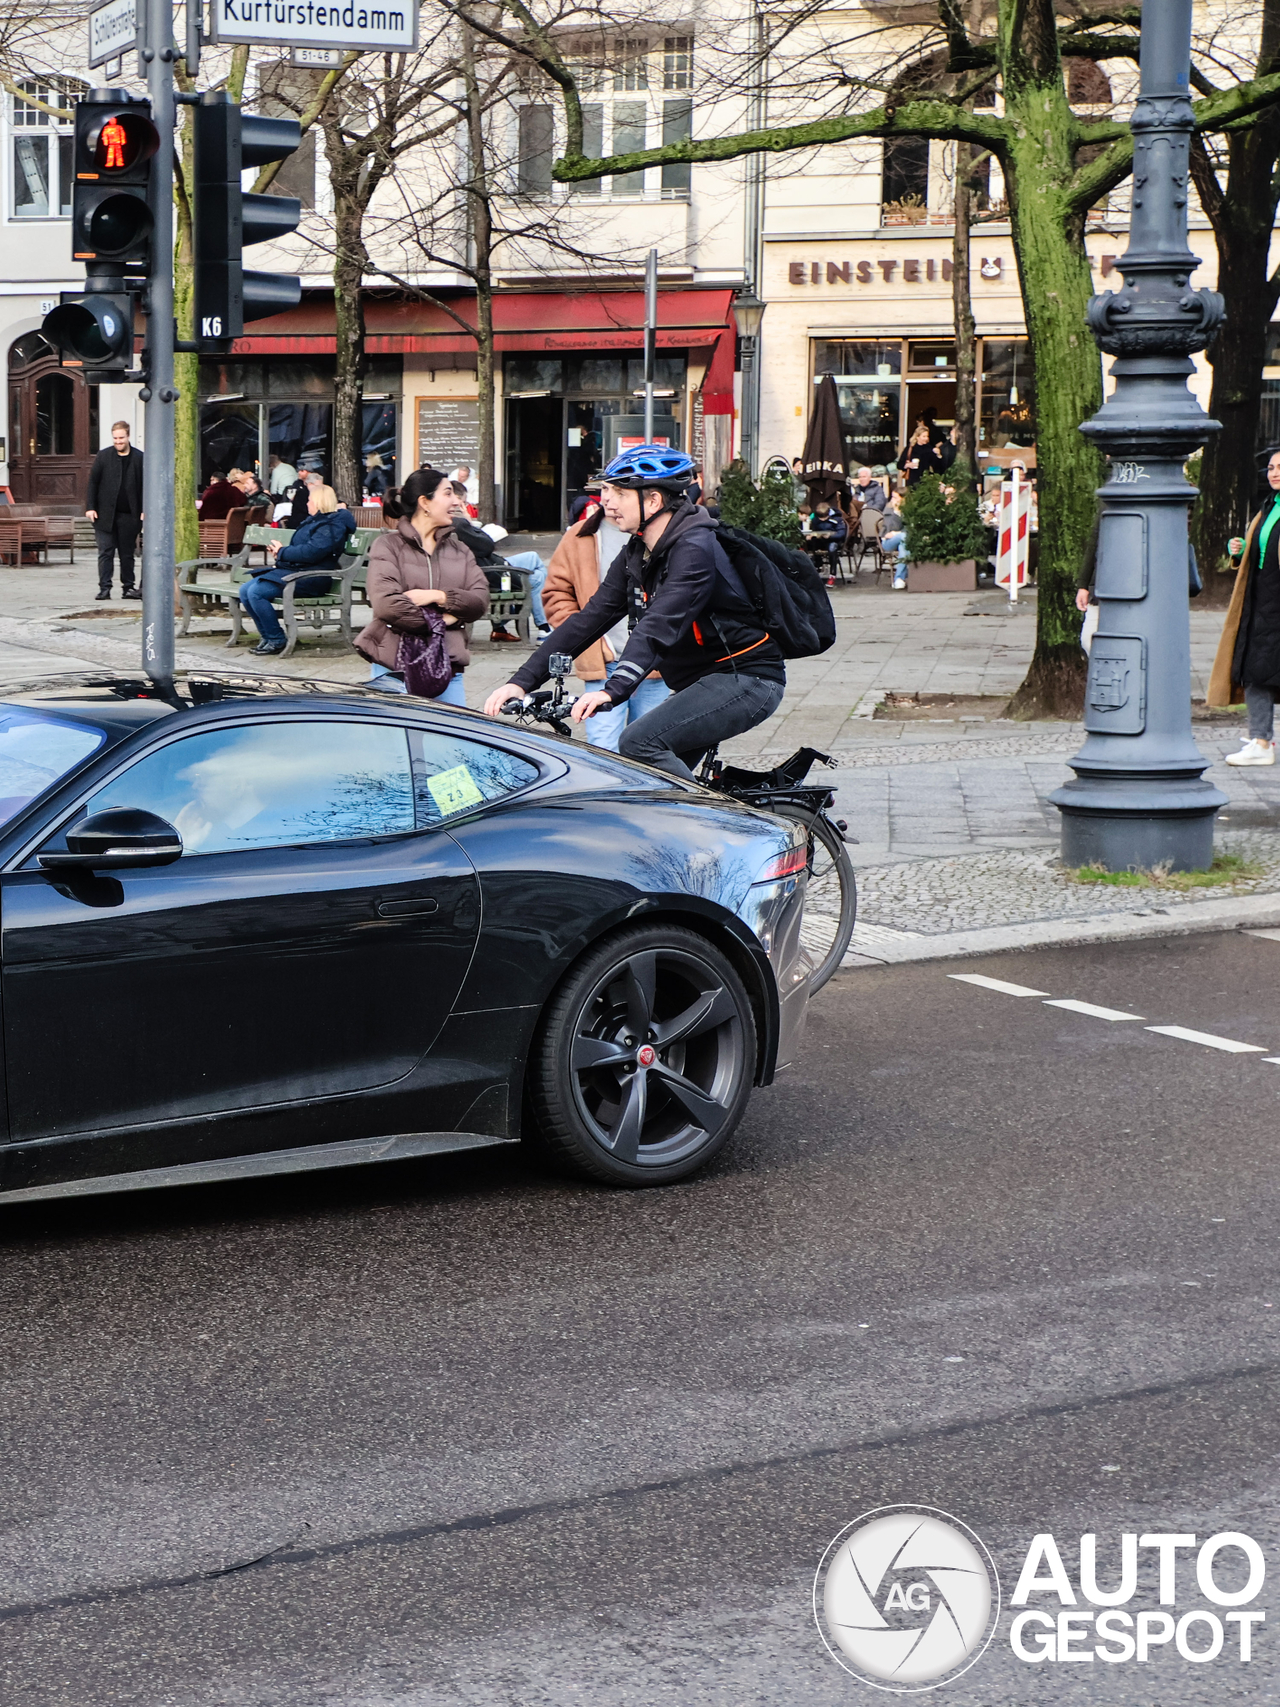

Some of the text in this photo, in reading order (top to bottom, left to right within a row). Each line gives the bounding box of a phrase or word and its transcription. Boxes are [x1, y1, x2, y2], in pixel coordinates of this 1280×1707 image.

[224, 0, 405, 31] Kurfürstendamm
[302, 51, 330, 62] 51-46
[42, 302, 51, 312] 51
[202, 316, 222, 337] K6
[854, 434, 892, 444] MOCHA
